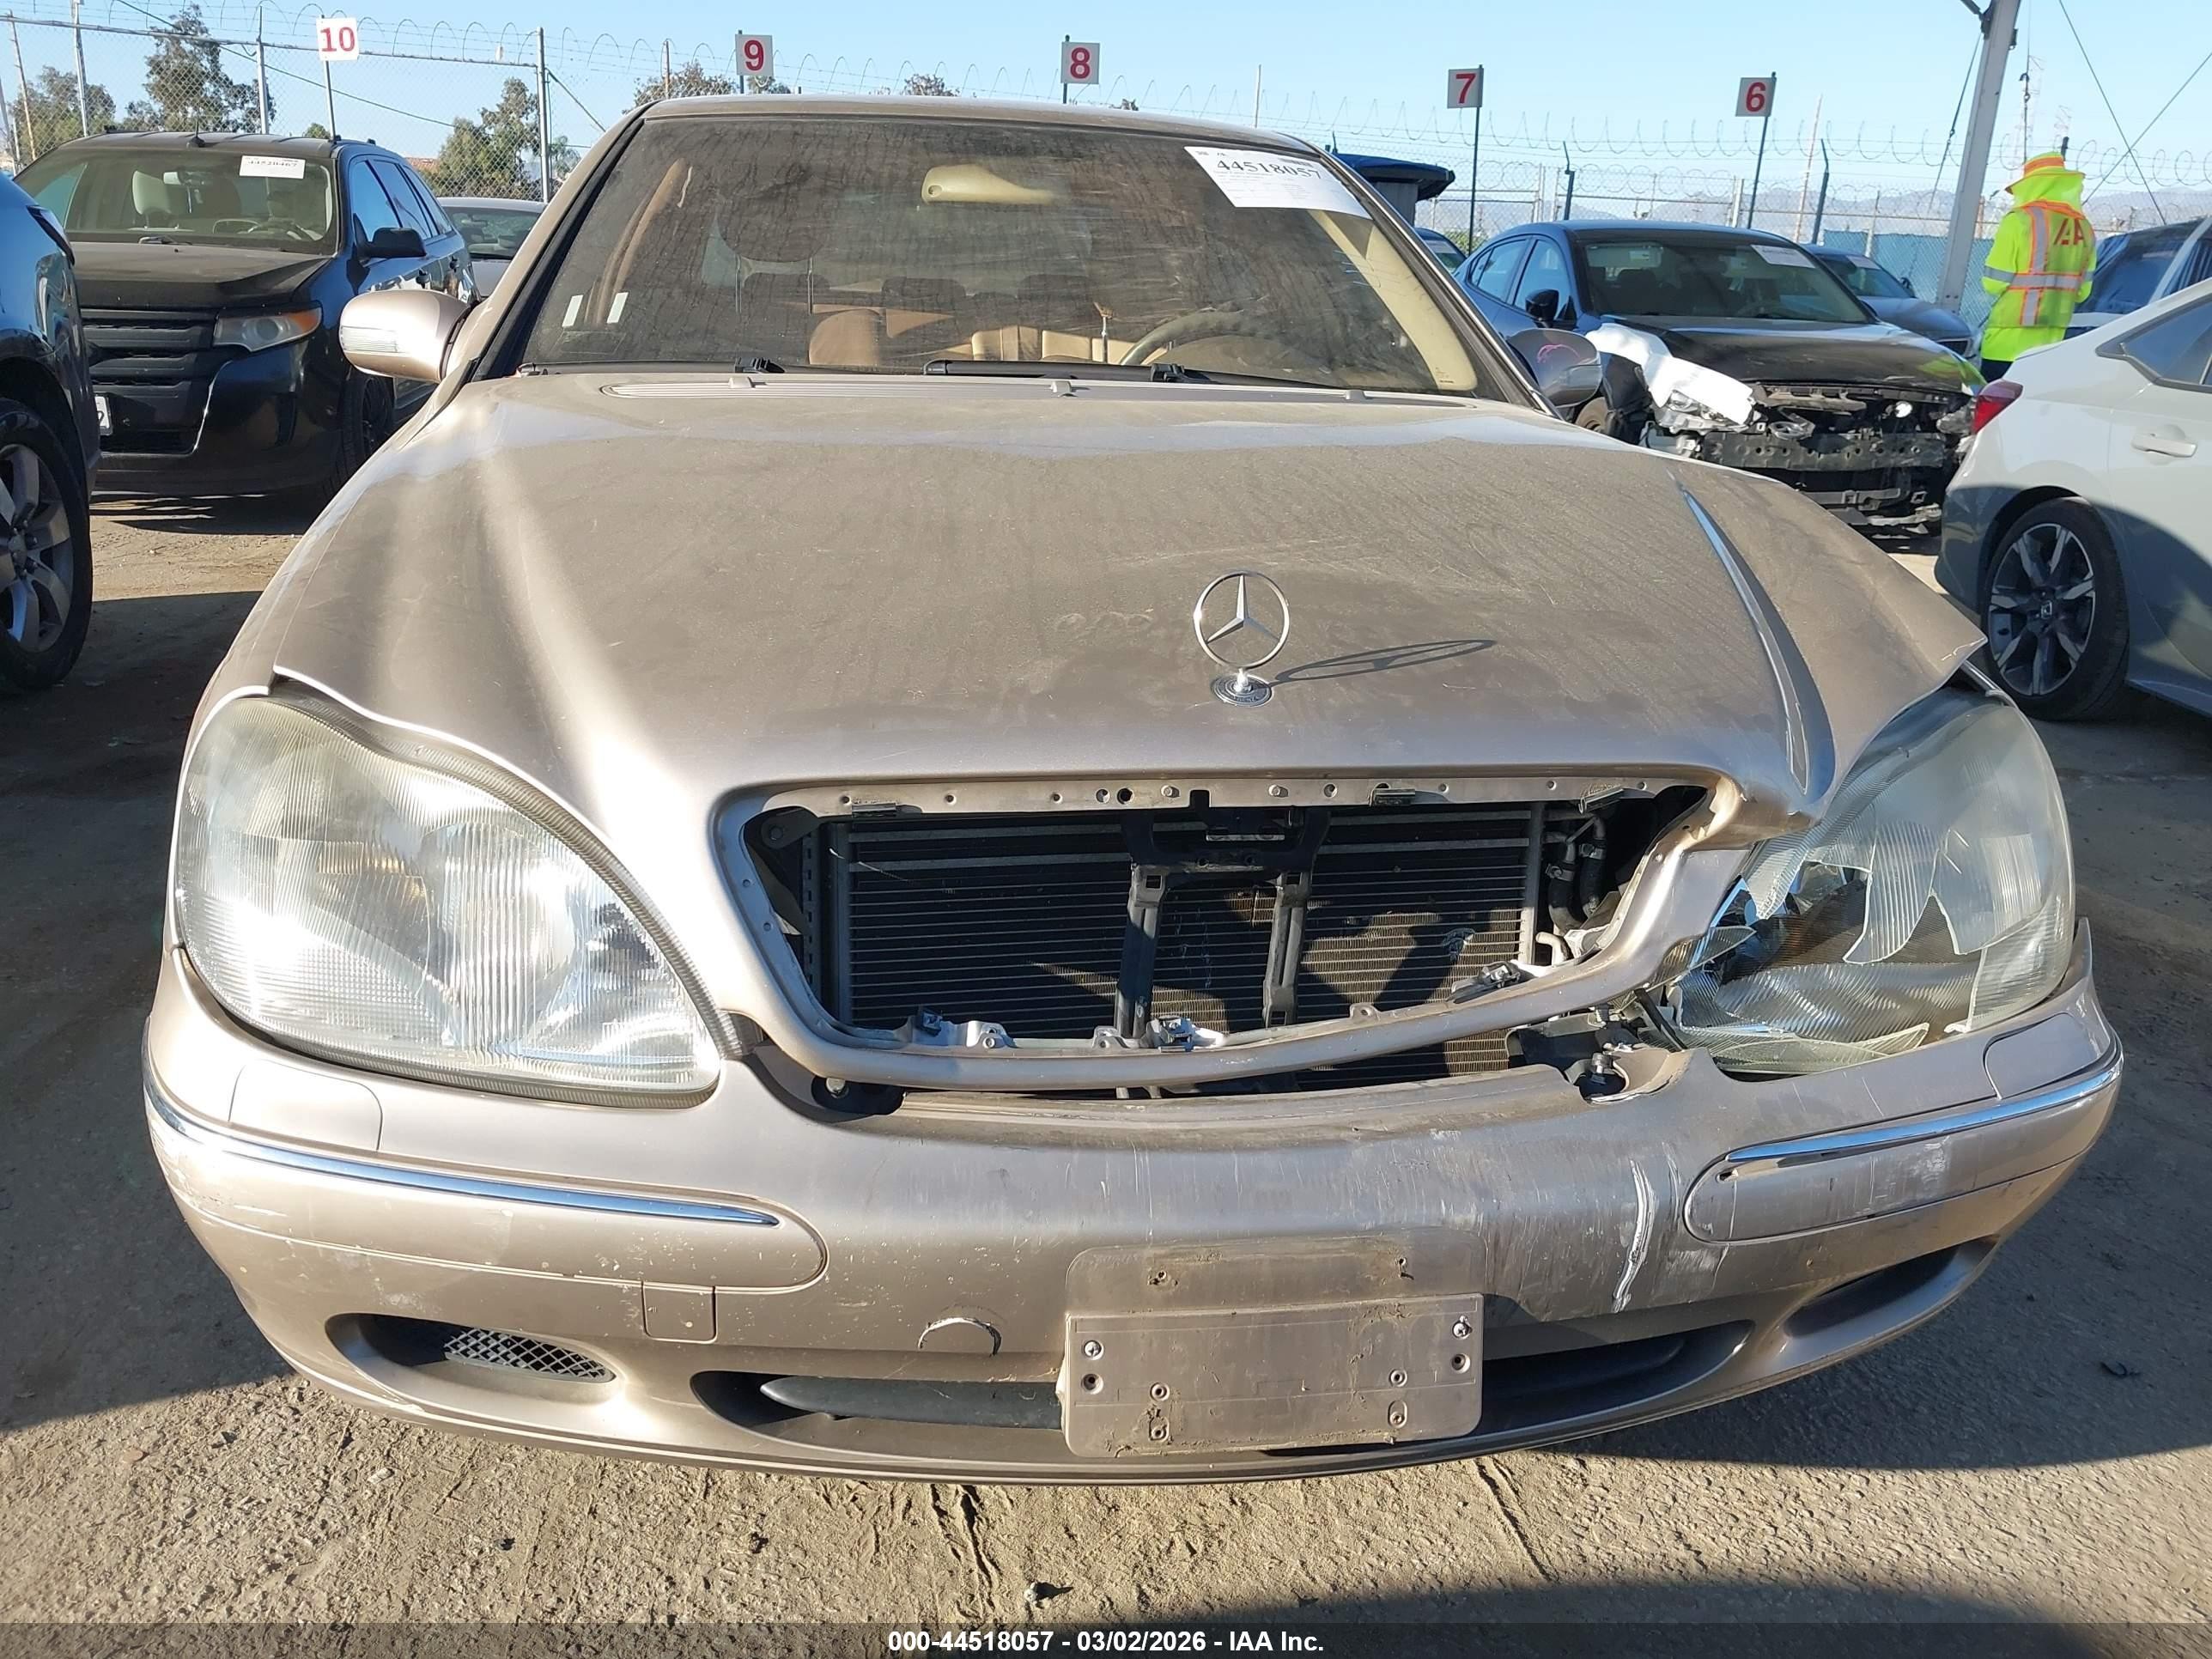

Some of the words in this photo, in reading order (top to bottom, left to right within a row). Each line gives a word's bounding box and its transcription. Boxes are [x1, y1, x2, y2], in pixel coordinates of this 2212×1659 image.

[320, 27, 356, 52] 10
[744, 40, 764, 71] 9
[1070, 47, 1091, 79] 8
[1455, 73, 1476, 104] 7
[1746, 82, 1766, 112] 6
[1217, 160, 1322, 179] 44518057
